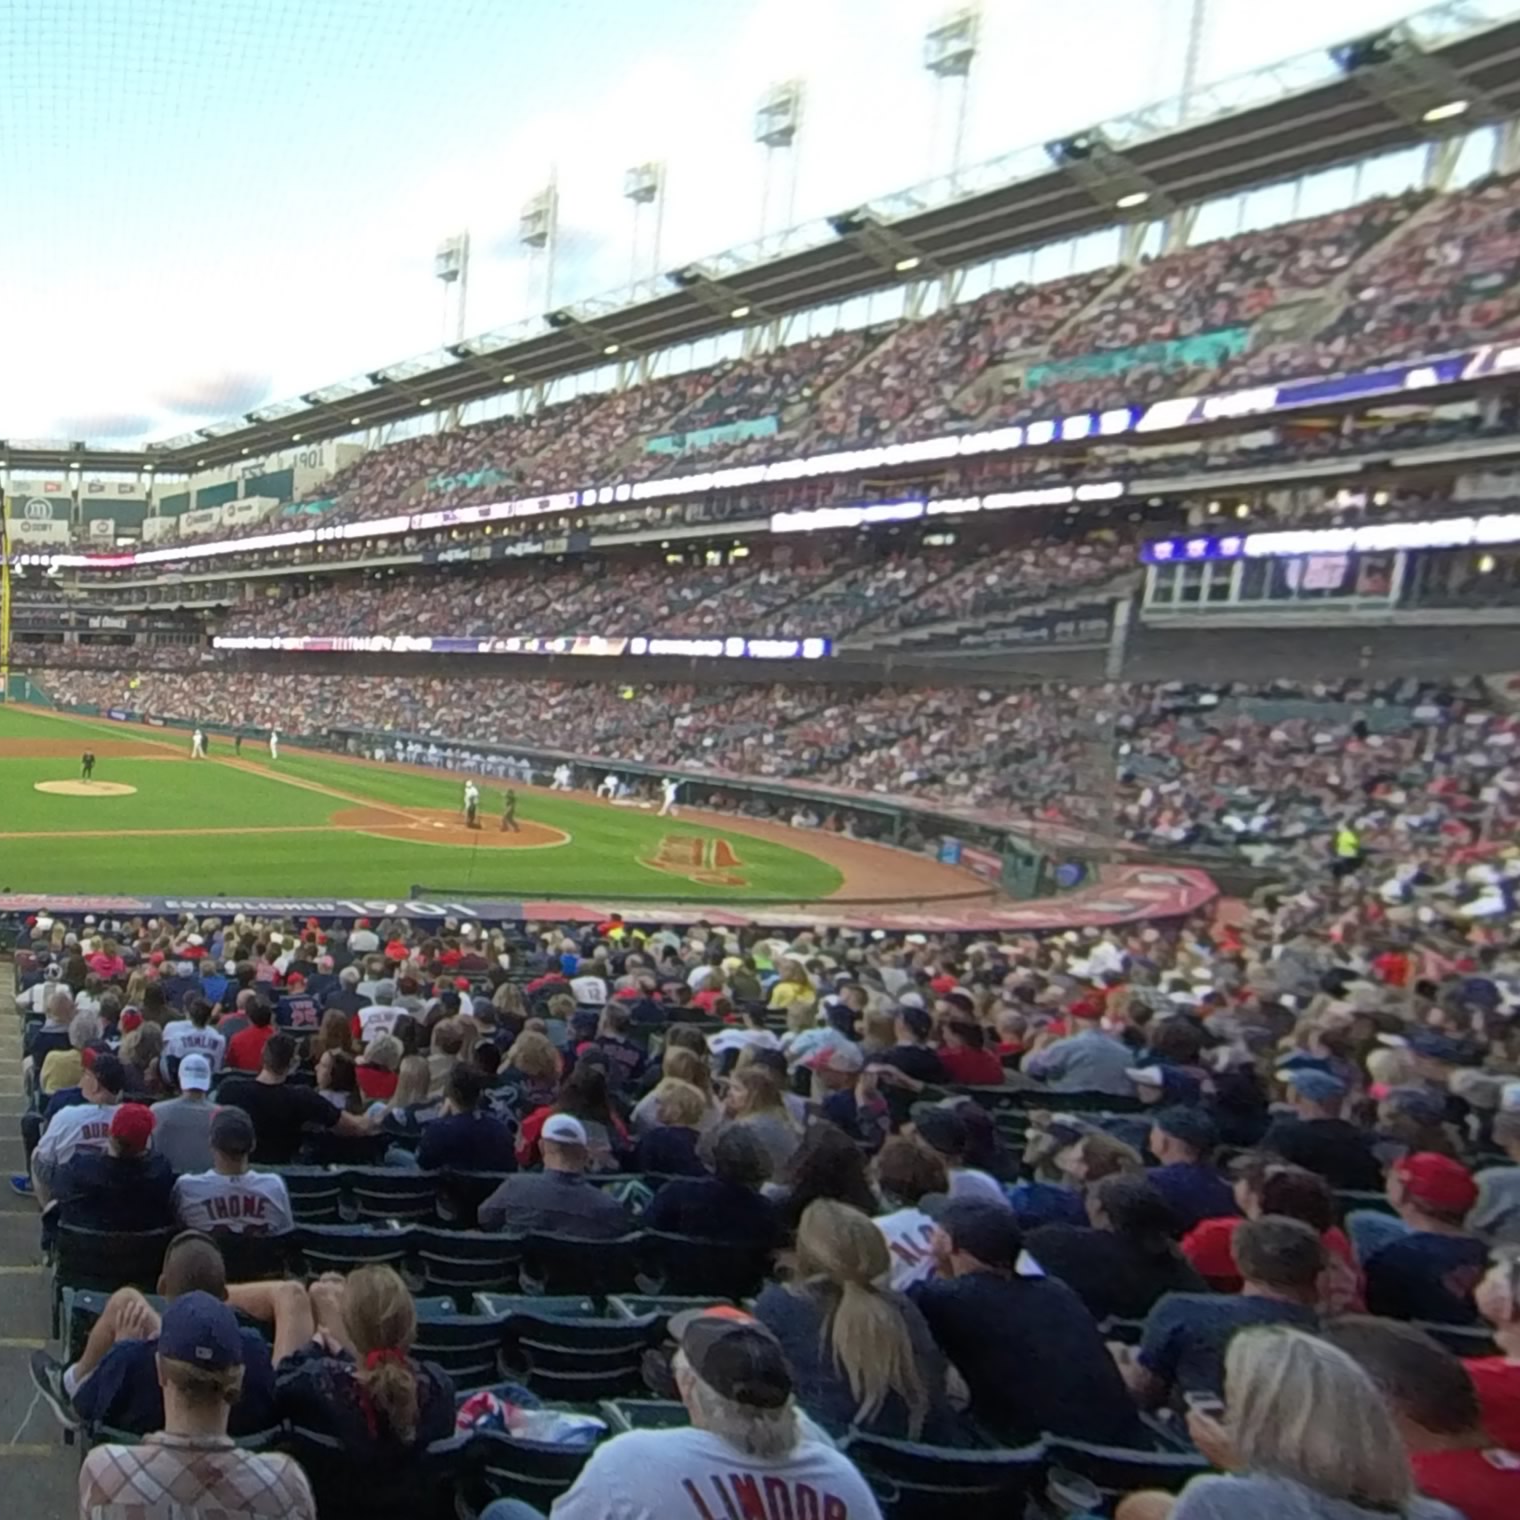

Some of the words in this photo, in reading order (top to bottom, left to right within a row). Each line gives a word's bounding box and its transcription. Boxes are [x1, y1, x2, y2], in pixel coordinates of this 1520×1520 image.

[165, 900, 335, 912] ESTABLISHED
[336, 900, 478, 916] 1901
[206, 1194, 266, 1220] THOME
